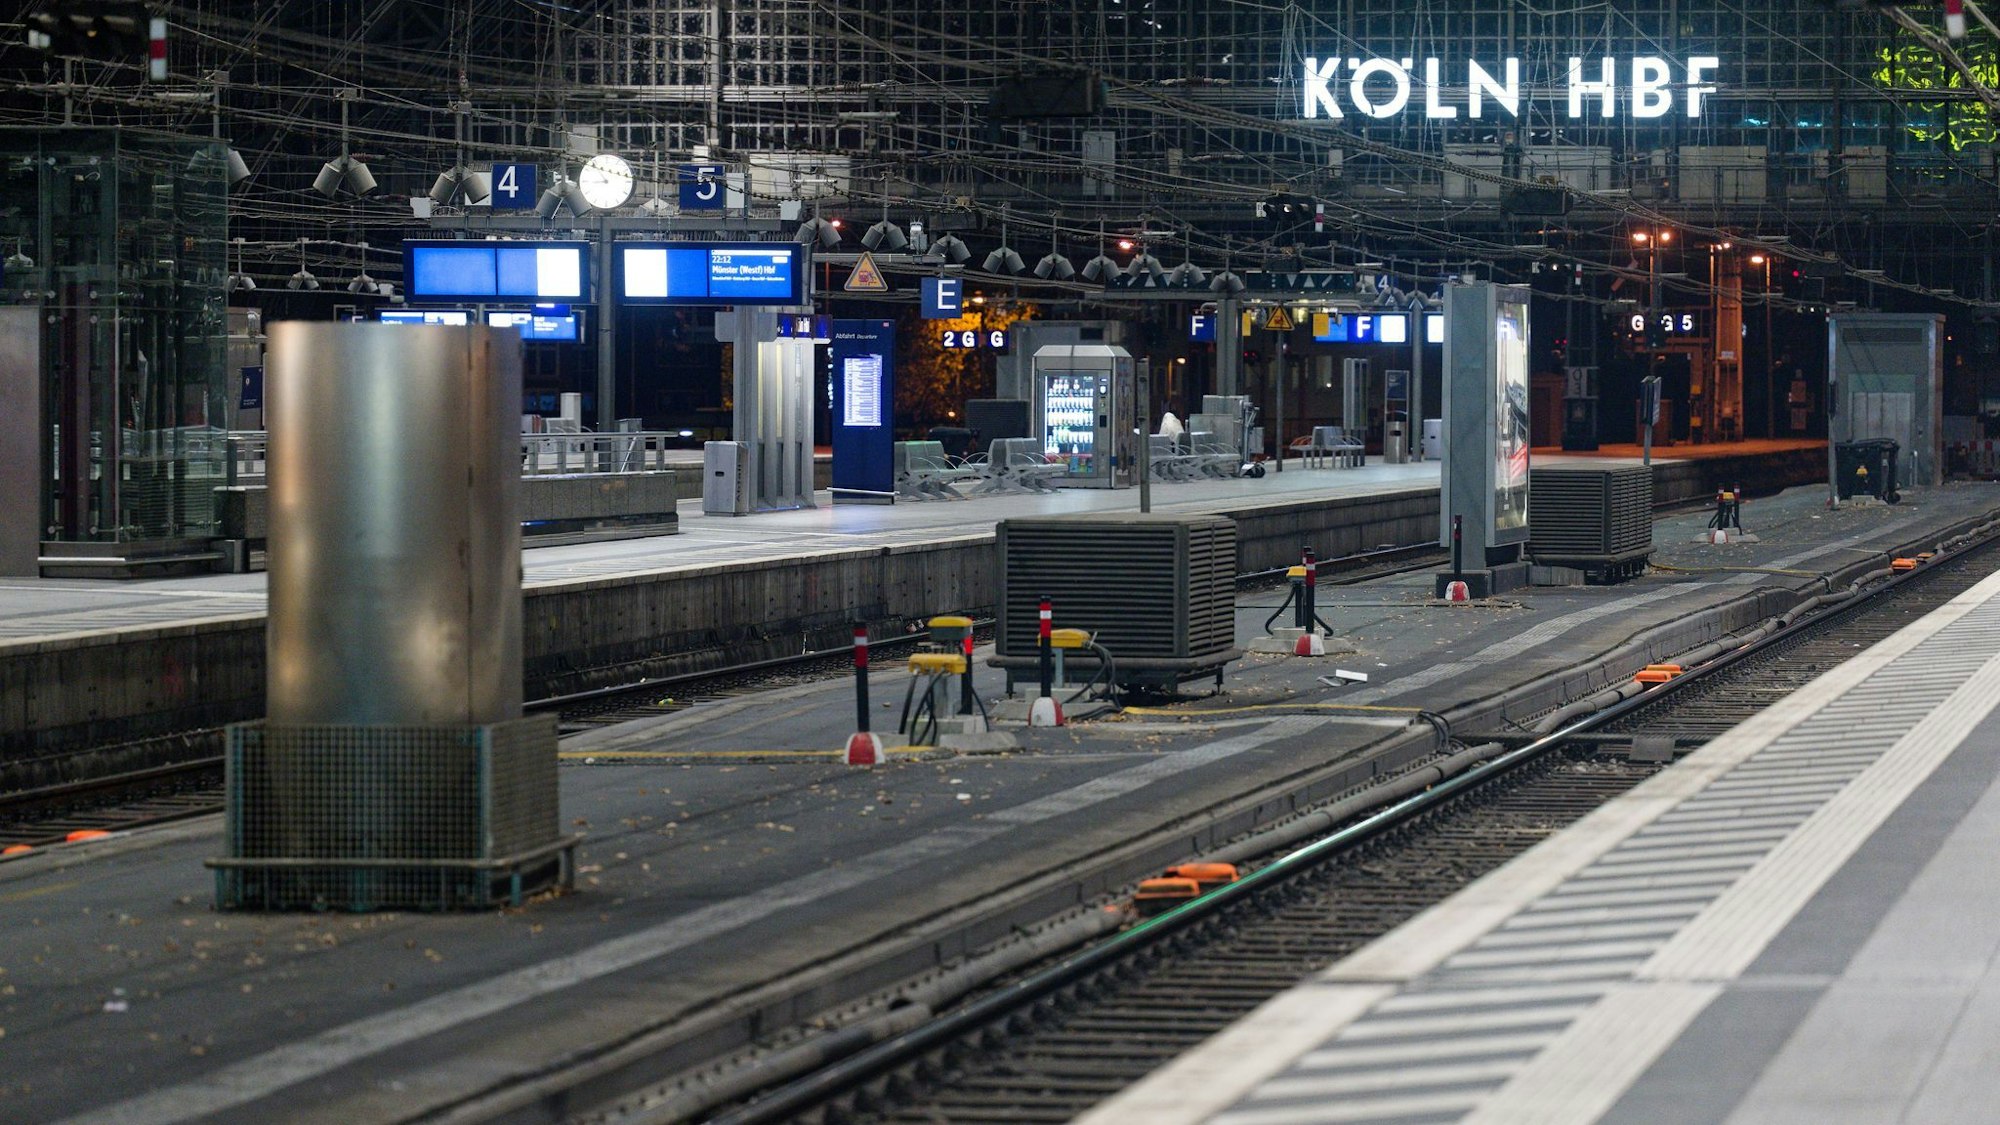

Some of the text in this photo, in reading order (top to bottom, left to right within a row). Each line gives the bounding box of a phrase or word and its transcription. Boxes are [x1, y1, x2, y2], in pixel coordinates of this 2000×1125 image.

[1304, 56, 1720, 119] KÖLN HBF
[497, 165, 519, 199] 4
[695, 166, 717, 201] 5
[712, 255, 732, 264] 22:12
[712, 265, 776, 275] Münster (Westf) Hbf
[1377, 274, 1389, 289] 4
[936, 279, 956, 310] E
[1191, 315, 1205, 336] F
[1356, 316, 1371, 338] F
[1631, 314, 1645, 331] G
[1681, 314, 1693, 331] 5
[943, 331, 1004, 348] 2 G G
